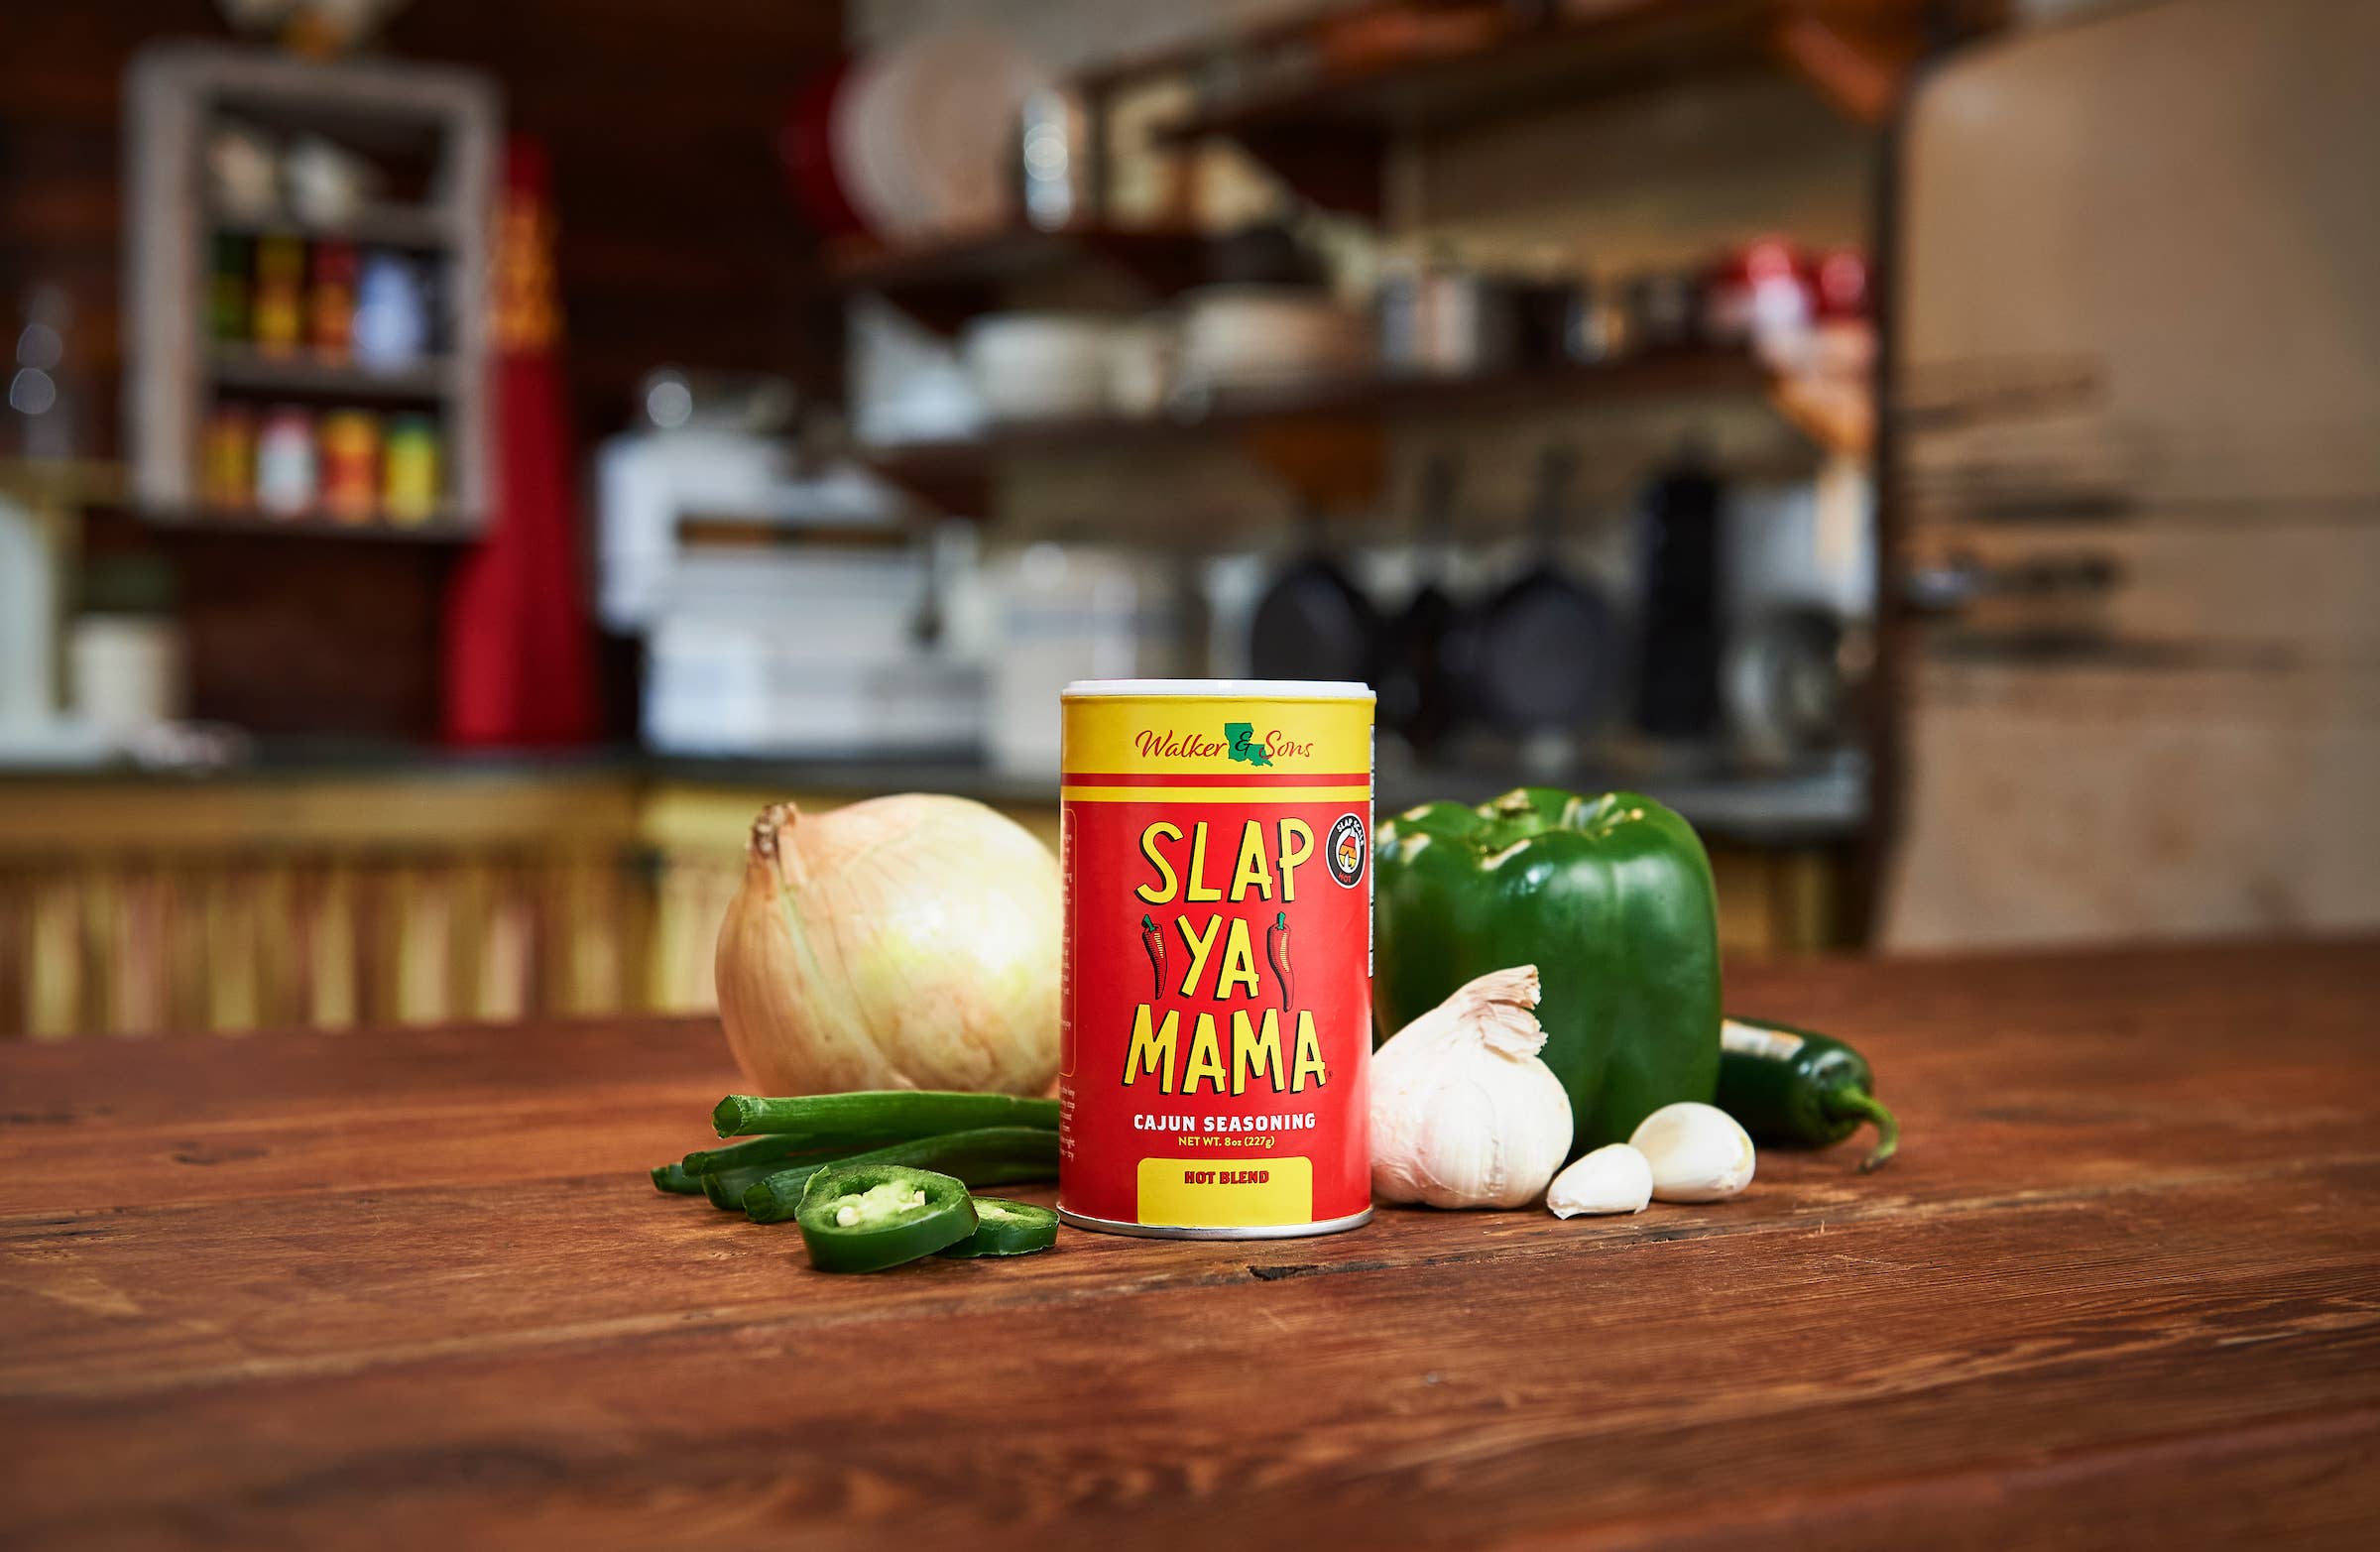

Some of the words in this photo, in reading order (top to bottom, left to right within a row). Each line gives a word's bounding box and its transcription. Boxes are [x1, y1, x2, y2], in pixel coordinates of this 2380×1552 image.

[1135, 729, 1227, 758] Walker
[1235, 731, 1253, 752] &
[1258, 729, 1314, 759] Sons
[1336, 818, 1352, 833] SLAP
[1133, 817, 1315, 904] SLAP
[1338, 872, 1352, 883] HOT
[1175, 912, 1259, 1001] YA
[1122, 1003, 1327, 1096] MAMA
[1133, 1114, 1195, 1132] CAJUN
[1203, 1113, 1316, 1133] SEASONING
[1178, 1135, 1201, 1146] NET
[1203, 1136, 1222, 1146] WT.
[1225, 1136, 1243, 1147] 8oz
[1244, 1135, 1275, 1149] (227g)
[1184, 1170, 1216, 1184] HOT
[1219, 1170, 1269, 1184] BLEND
